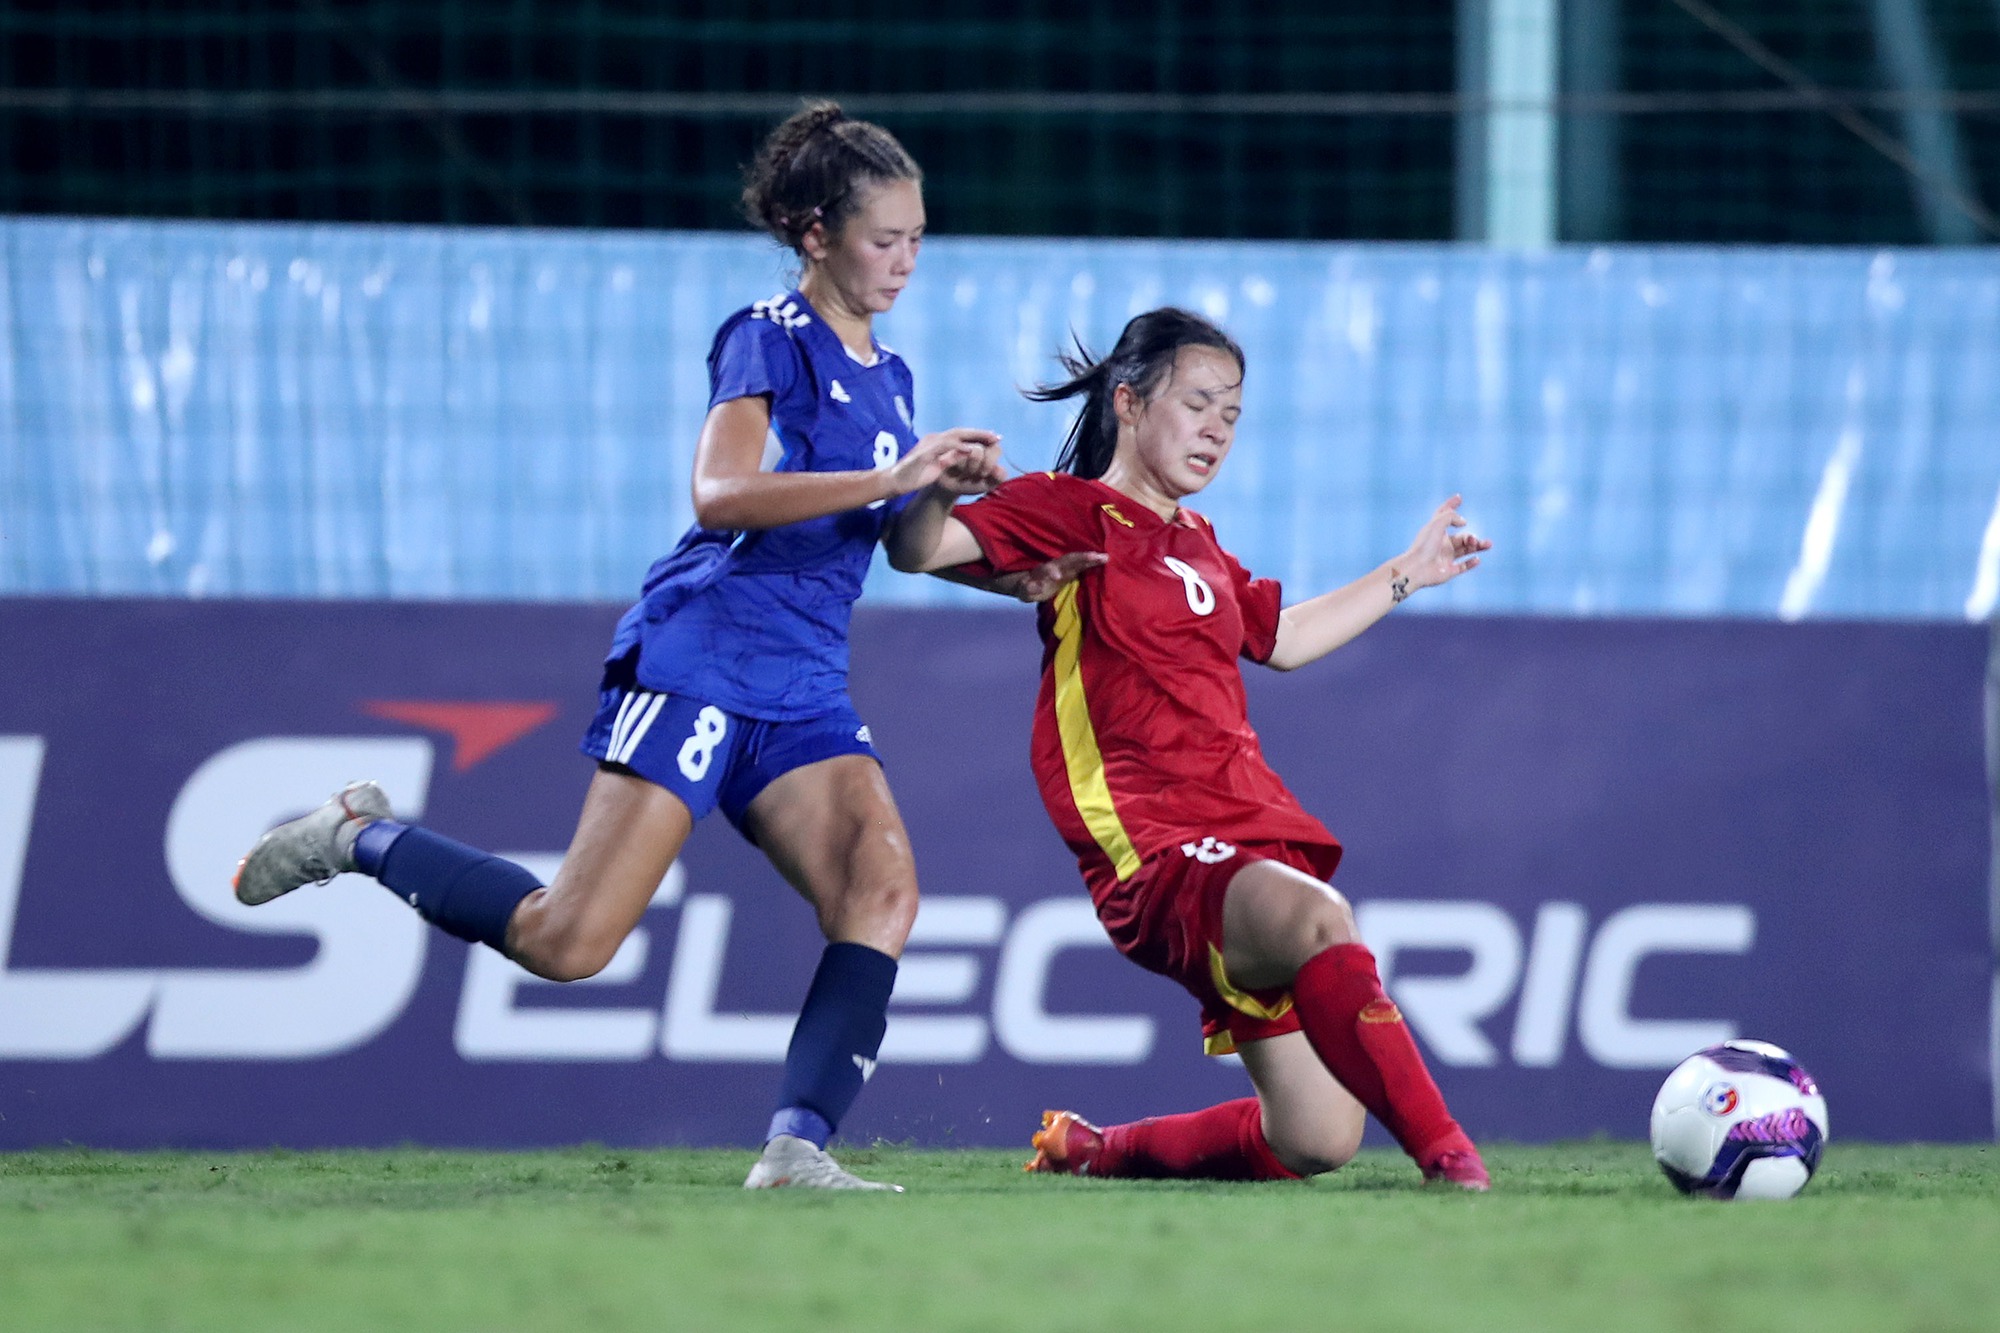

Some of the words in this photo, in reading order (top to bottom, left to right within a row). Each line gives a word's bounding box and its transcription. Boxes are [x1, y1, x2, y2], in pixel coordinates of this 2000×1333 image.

[1163, 556, 1216, 616] 8
[677, 705, 727, 782] 8
[453, 850, 1758, 1067] ELECRIC
